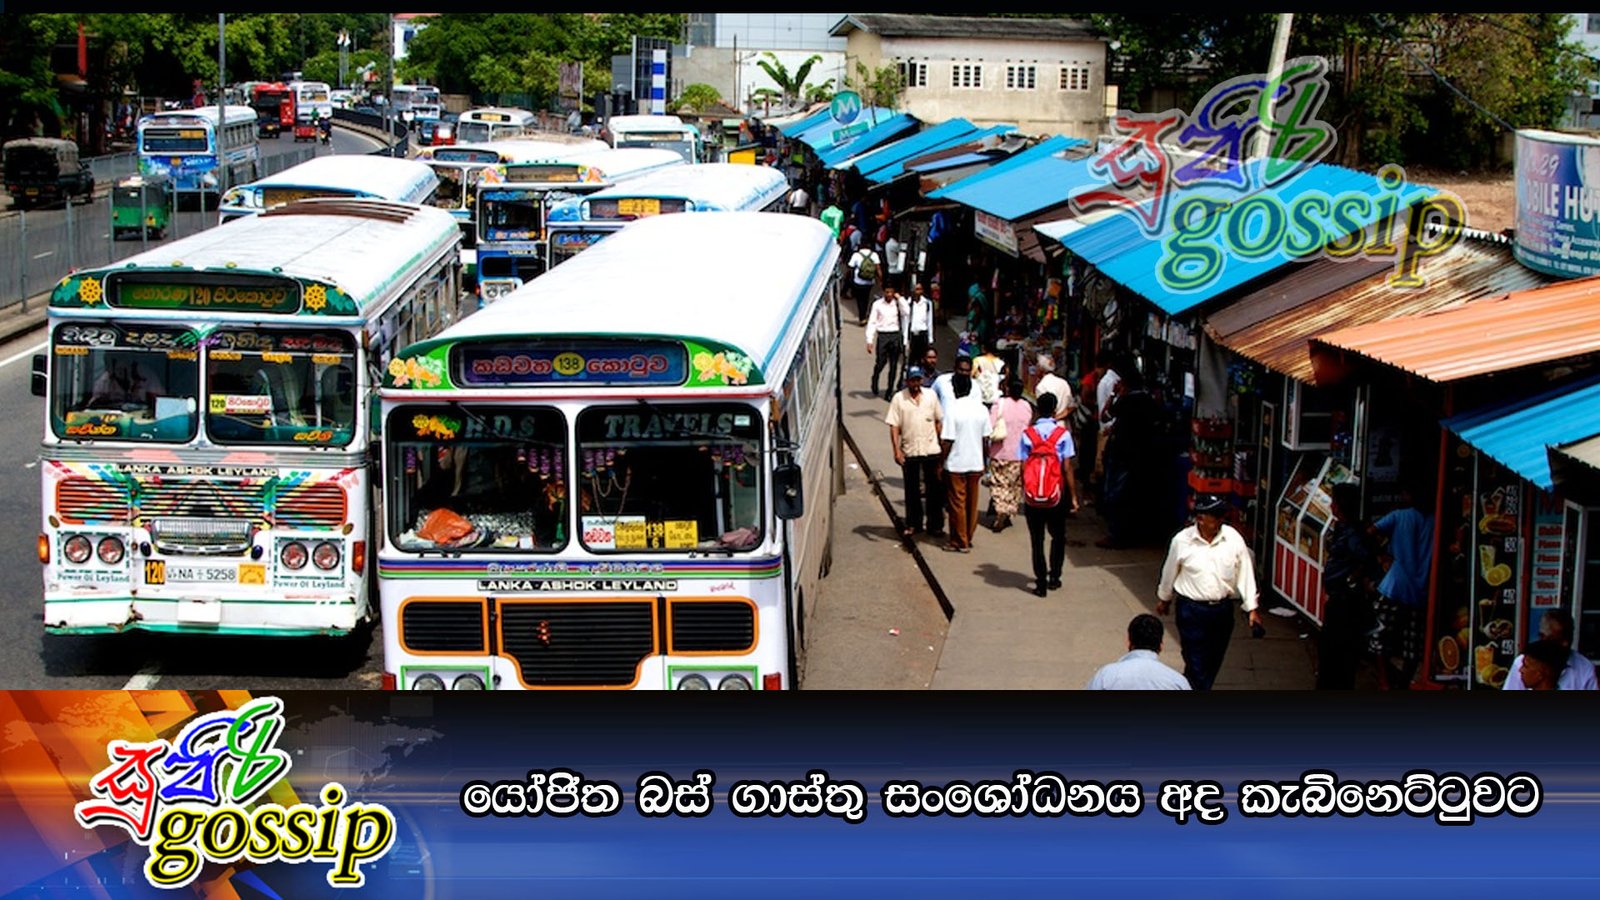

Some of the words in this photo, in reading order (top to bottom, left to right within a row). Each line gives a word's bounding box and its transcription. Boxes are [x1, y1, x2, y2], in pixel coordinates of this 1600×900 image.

[559, 357, 580, 371] 138
[587, 354, 668, 377] කොටුව
[212, 399, 225, 409] 120
[605, 415, 734, 439] TRAVELS
[117, 463, 160, 473] LANKA
[167, 465, 213, 475] ASHOK
[217, 466, 278, 477] LEYLAND
[652, 537, 660, 550] 6
[57, 573, 81, 582] Power
[96, 574, 130, 584] Leyland
[145, 562, 165, 584] 120
[207, 569, 235, 581] 5258
[273, 580, 298, 588] Power
[311, 581, 345, 590] Leyland
[478, 580, 533, 591] LANKA
[538, 580, 596, 591] ASHOK
[602, 580, 678, 591] LEYLAND
